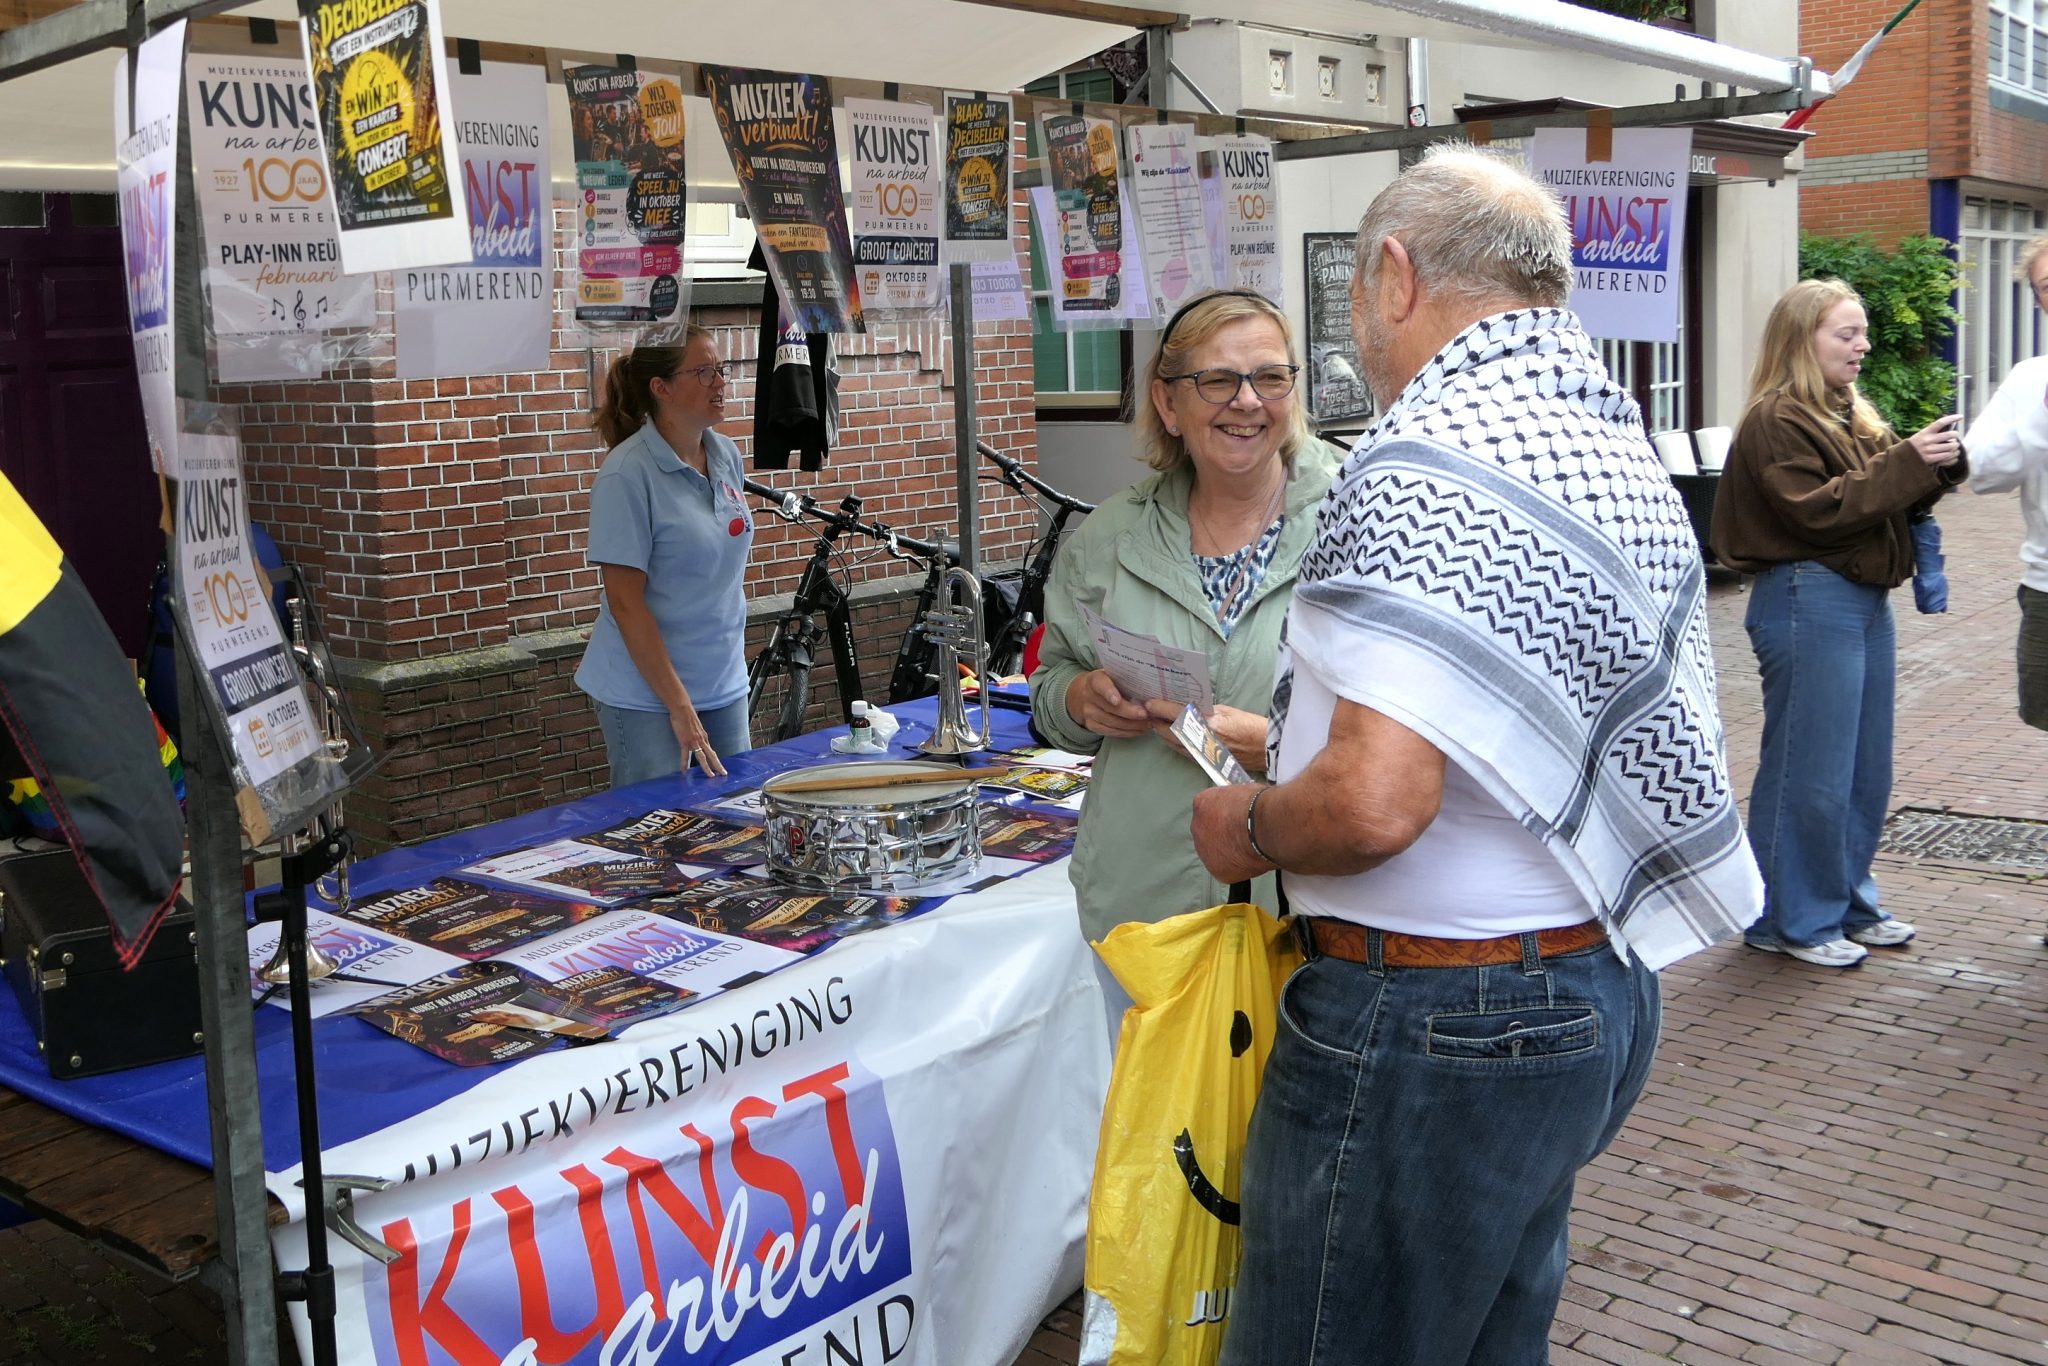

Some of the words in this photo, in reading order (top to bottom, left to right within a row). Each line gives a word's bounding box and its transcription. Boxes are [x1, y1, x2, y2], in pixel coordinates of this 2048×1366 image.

[335, 42, 349, 58] MET
[351, 37, 363, 50] EEN
[364, 9, 415, 46] INSTRUMENT?
[573, 78, 598, 94] KUNST
[599, 77, 609, 91] NA
[611, 74, 634, 89] ARBEID
[647, 86, 667, 101] WIJ
[198, 80, 316, 129] KUNS
[346, 100, 355, 115] EN
[356, 85, 382, 117] WIN
[386, 80, 399, 103] JIJ
[645, 100, 677, 118] ZOEKEN
[730, 82, 806, 121] MUZIEK
[653, 111, 681, 139] JOU!
[853, 112, 928, 125] MUZIEKVERENIGING
[956, 103, 983, 125] BLAAS
[985, 104, 996, 118] JIJ
[455, 121, 539, 148] VERENIGING
[740, 110, 818, 146] verbindt!
[954, 127, 1005, 150] DECIBELLEN
[1049, 125, 1064, 141] KUNST
[1064, 125, 1070, 136] NA
[1070, 121, 1085, 135] ARBEID
[225, 137, 260, 149] na
[266, 129, 320, 152] arbe
[854, 124, 930, 166] KUNST
[357, 132, 408, 176] CONCERT
[751, 156, 768, 169] KUNST
[769, 158, 778, 169] NA
[778, 158, 797, 171] ARBEID
[1223, 151, 1270, 178] KUNST
[214, 176, 238, 186] 1927
[242, 157, 327, 202] 100
[583, 175, 606, 186] NIEUWE
[608, 175, 627, 186] LEDEN!
[866, 168, 885, 178] na
[887, 164, 930, 183] arbeid
[967, 173, 981, 186] WIN
[1141, 169, 1149, 178] Wij
[1150, 169, 1158, 177] zijn
[1231, 181, 1243, 190] na
[1244, 177, 1271, 191] arbeid
[1542, 169, 1675, 187] MUZIEKVERENIGING
[637, 180, 664, 195] SPEEL
[667, 180, 680, 193] JIJ
[773, 193, 783, 203] EN
[465, 159, 536, 248] NST
[640, 197, 648, 208] IN
[649, 195, 681, 208] OKTOBER
[859, 195, 873, 203] 1927
[875, 183, 918, 217] 100
[961, 199, 992, 215] CONCERT
[1091, 201, 1108, 214] SPEEL
[1237, 194, 1265, 220] 100
[224, 213, 334, 223] PURMERE
[645, 208, 672, 225] MEE
[865, 221, 928, 231] PURMEREND
[1562, 195, 1669, 249] UNST
[472, 201, 535, 257] rbeid
[1097, 223, 1114, 237] MEE
[221, 243, 302, 264] PLAY-INN
[860, 241, 891, 260] GROOT
[893, 241, 934, 260] CONCERT
[1230, 243, 1256, 255] PLAY-INN
[1256, 240, 1275, 254] REÜNIE
[1582, 224, 1663, 264] arbeid
[256, 264, 338, 293] februari
[408, 272, 543, 301] PURMEREND
[885, 272, 927, 282] OKTOBER
[1577, 271, 1666, 293] MEREND
[184, 478, 239, 544] KUNST
[194, 553, 209, 571] na
[210, 535, 241, 565] arbeid
[204, 570, 249, 628] 100
[211, 625, 270, 654] PURMEREND
[844, 622, 856, 667] FLYER
[221, 668, 258, 705] GROOT
[253, 652, 293, 693] CONCERT
[267, 700, 301, 728] OKTOBER
[604, 808, 680, 840] MUZIEK
[603, 861, 655, 871] MUZIEK
[348, 887, 440, 920] MUZIEK
[747, 900, 760, 908] EN
[520, 914, 647, 962] MUZIEKVERENIGING
[633, 933, 707, 972] arbeid
[553, 968, 608, 990] MUZIEK
[411, 1000, 439, 1014] KUNST
[439, 996, 450, 1008] NA
[449, 988, 477, 1006] ARBEID
[475, 975, 520, 996] PURMEREND
[502, 1041, 536, 1056] OKTOBER
[380, 1061, 874, 1366] KUNST
[599, 1147, 885, 1366] arbeid
